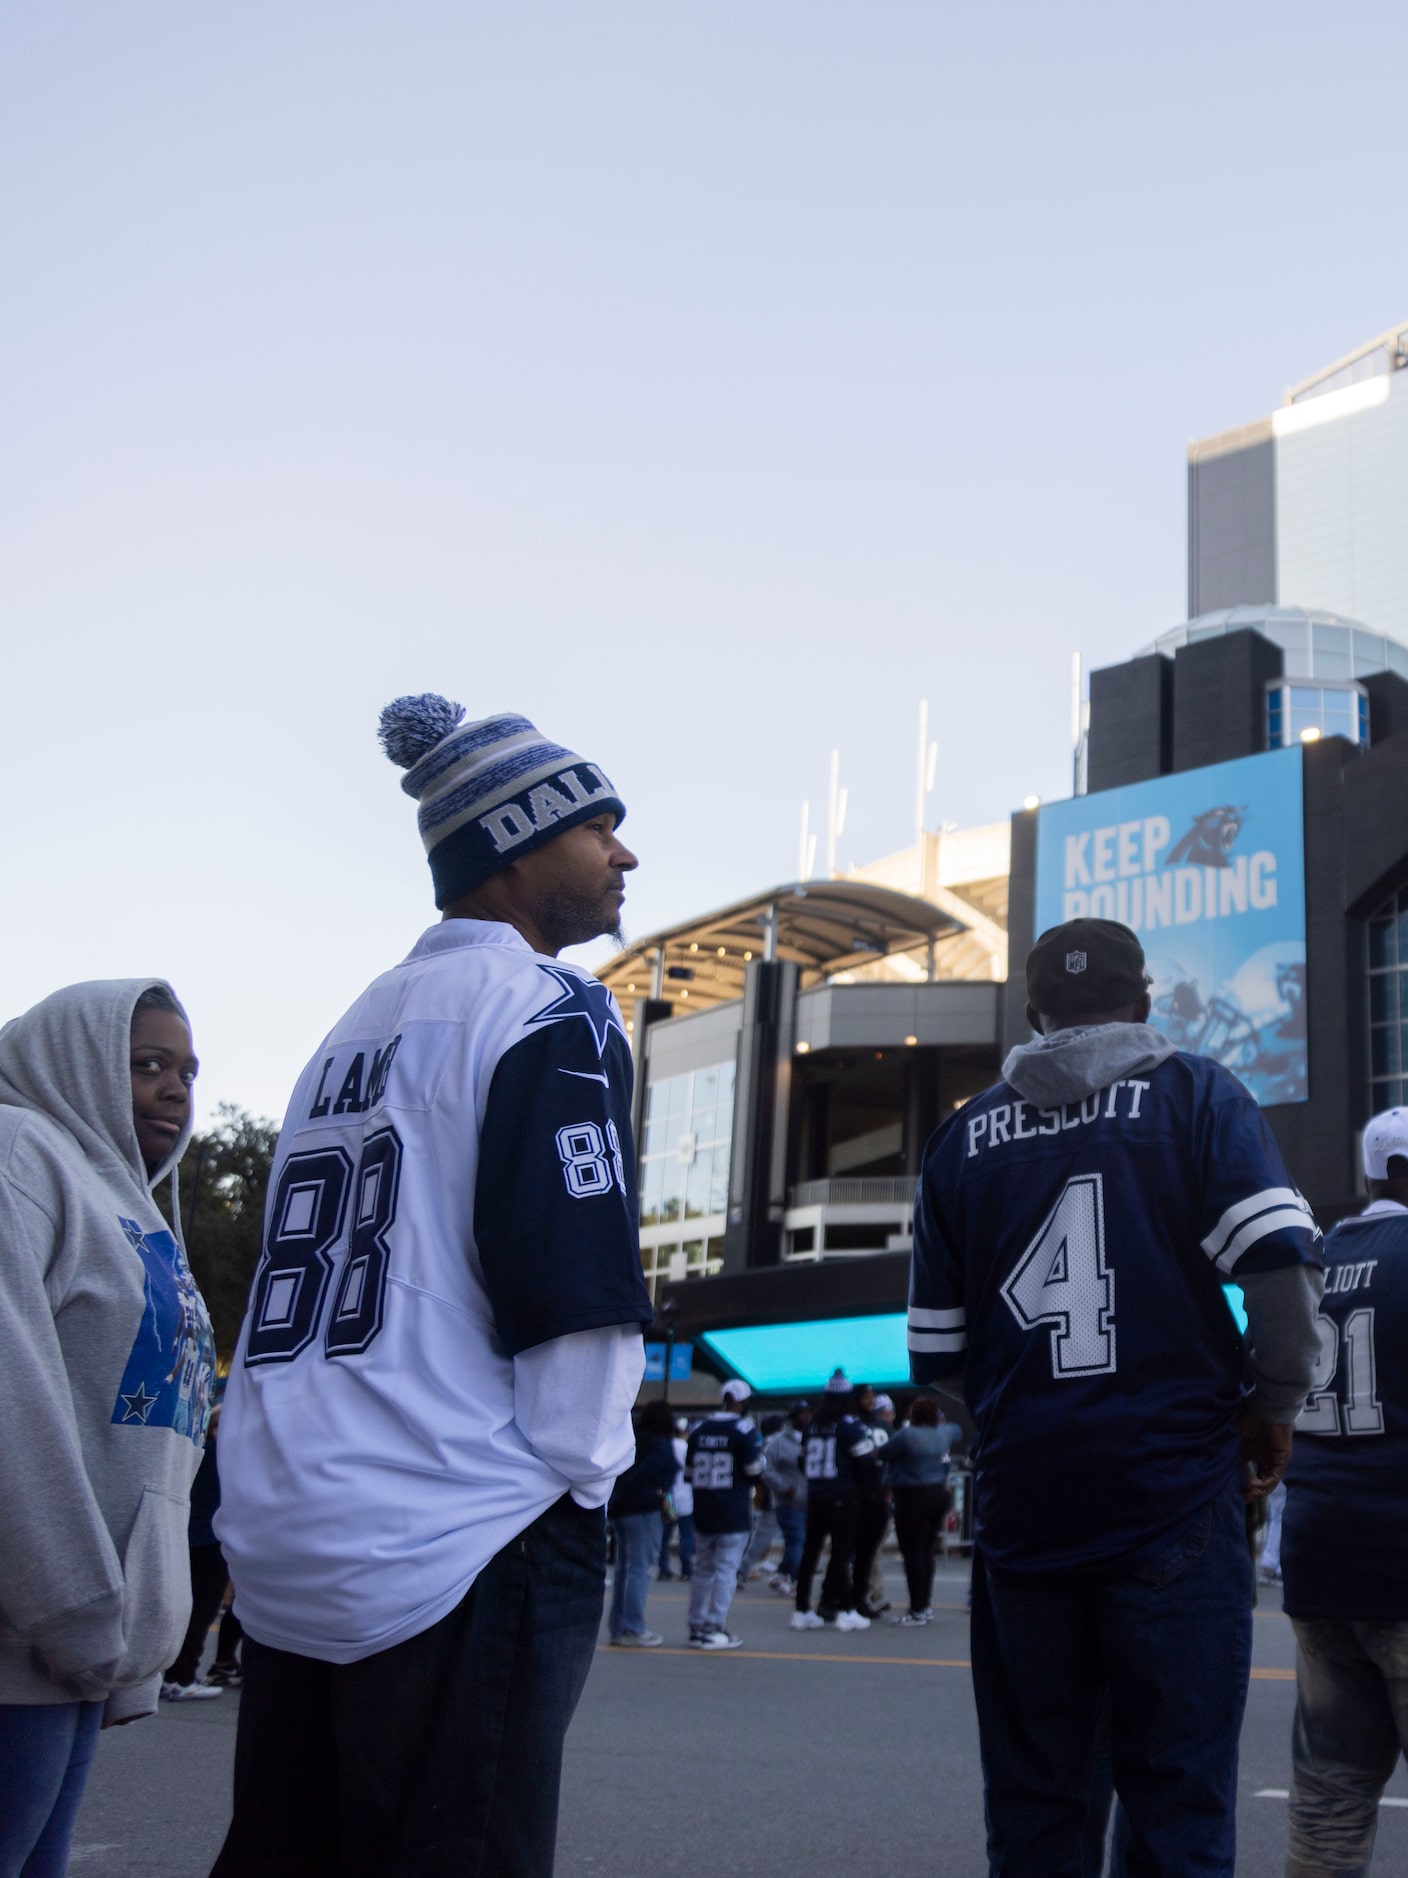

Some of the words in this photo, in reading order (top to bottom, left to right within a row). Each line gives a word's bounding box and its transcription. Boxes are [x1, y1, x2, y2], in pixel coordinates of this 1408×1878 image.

[1064, 815, 1170, 889] KEEP
[245, 1125, 403, 1369] 88
[1000, 1173, 1116, 1379] 4
[1293, 1307, 1385, 1436] 21
[692, 1451, 734, 1490] 22
[804, 1436, 838, 1479] 21
